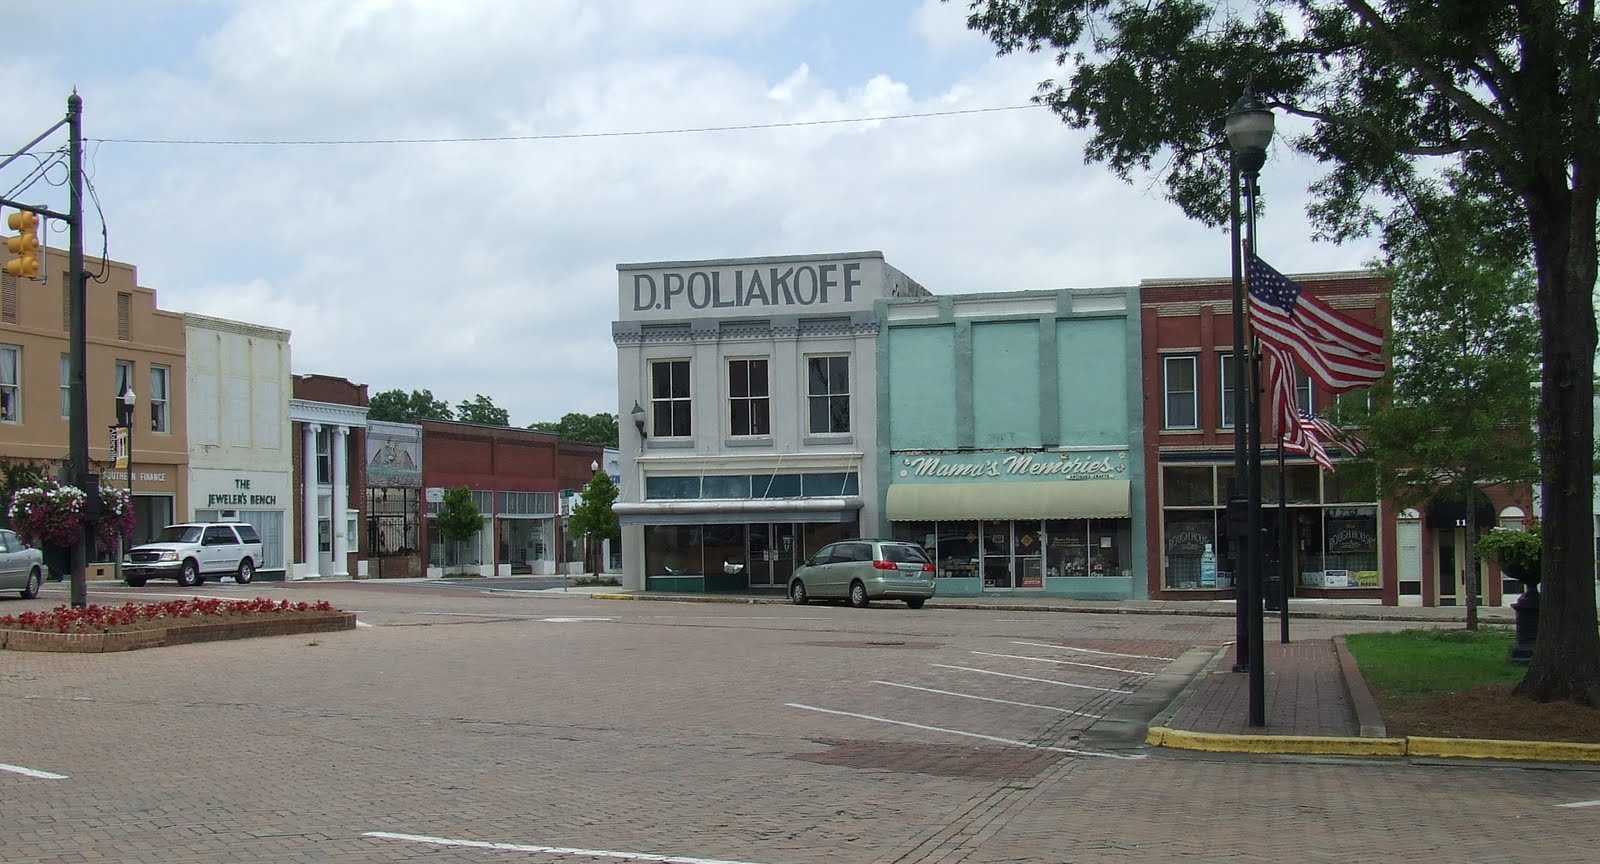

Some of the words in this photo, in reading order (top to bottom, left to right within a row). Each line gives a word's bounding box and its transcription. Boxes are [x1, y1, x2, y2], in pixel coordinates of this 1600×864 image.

[109, 428, 117, 462] Abbeville
[910, 457, 999, 477] Mama's
[1002, 455, 1114, 475] Memories
[102, 471, 136, 481] SOUTHEN
[140, 472, 166, 482] FINANCE
[234, 479, 251, 490] THE
[207, 492, 248, 507] JEWELER'S
[250, 494, 276, 505] BENCH
[1168, 531, 1190, 551] ROUGH
[1328, 530, 1351, 551] ROUGH
